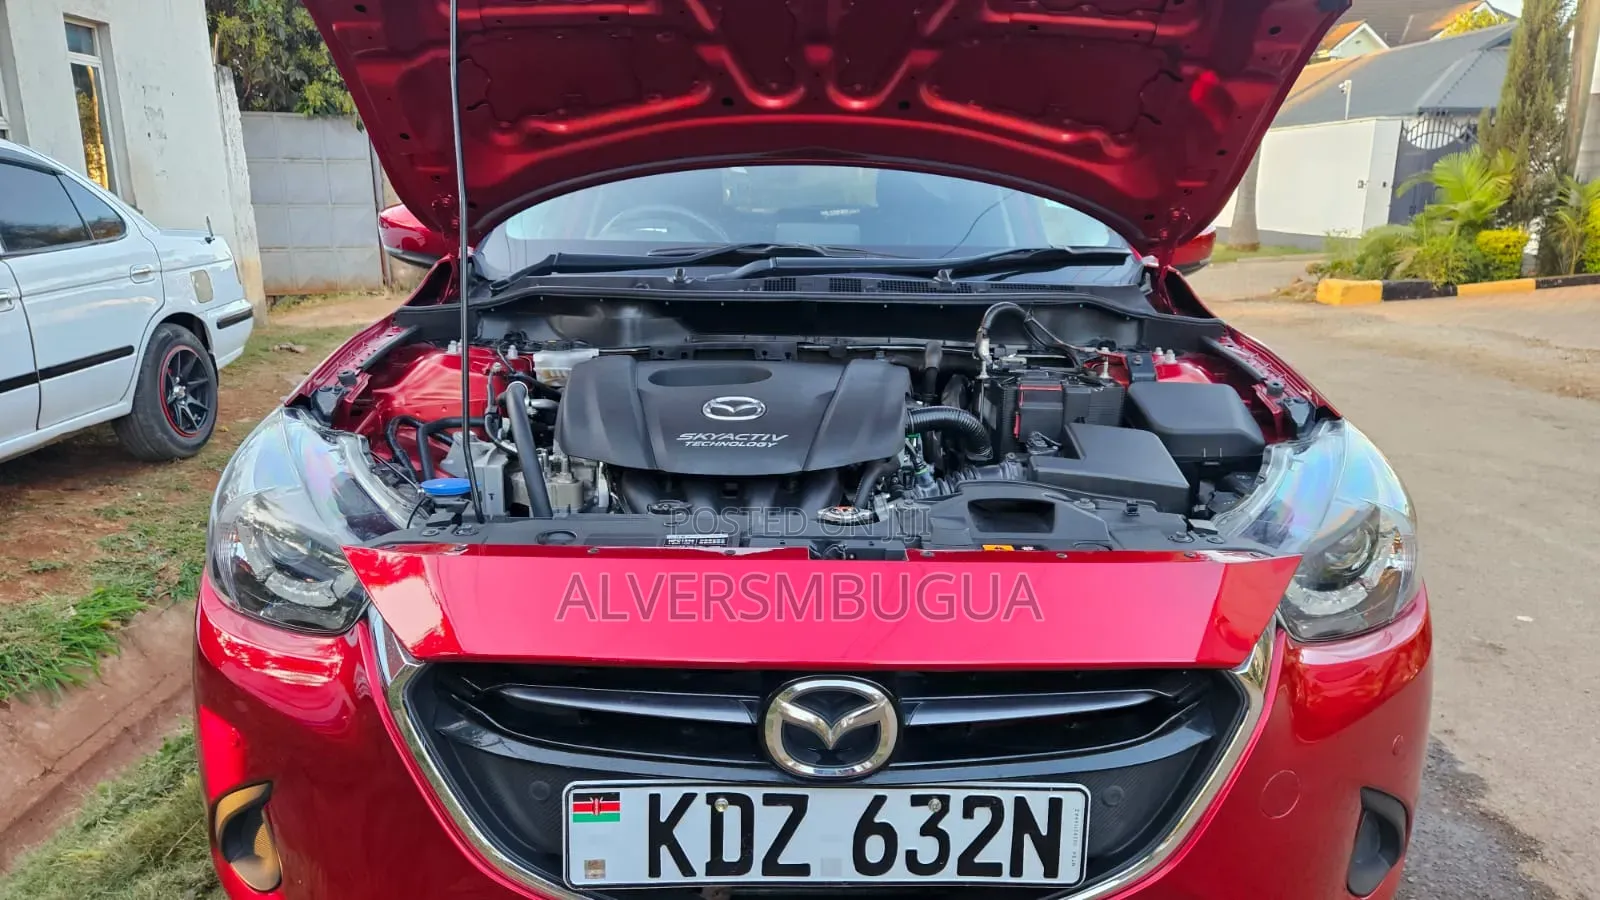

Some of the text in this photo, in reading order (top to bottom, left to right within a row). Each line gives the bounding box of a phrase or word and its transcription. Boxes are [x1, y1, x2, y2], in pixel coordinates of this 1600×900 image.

[676, 433, 789, 441] SKYACTIV
[648, 792, 811, 878] KDZ
[852, 795, 1063, 879] 632N
